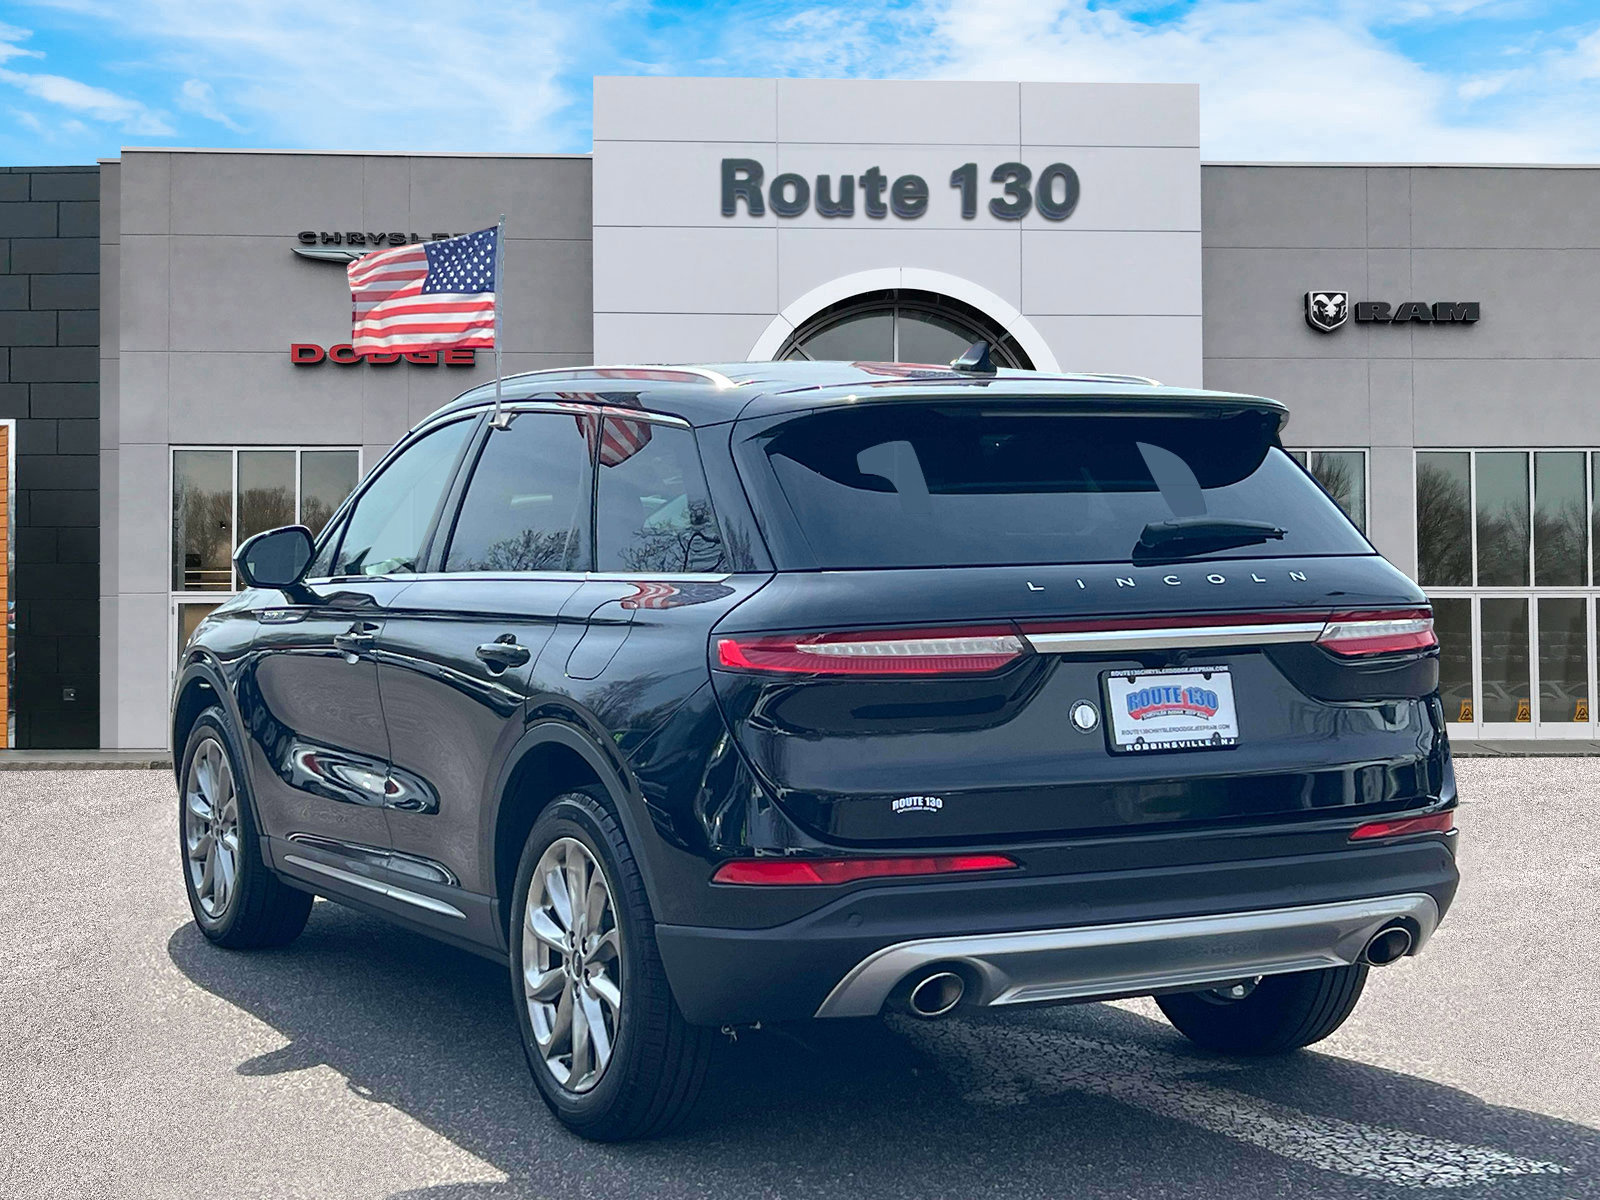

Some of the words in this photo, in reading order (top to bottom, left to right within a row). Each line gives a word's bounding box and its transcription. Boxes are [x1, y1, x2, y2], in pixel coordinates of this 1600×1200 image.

[720, 158, 929, 219] Route
[949, 162, 1080, 221] 130
[1354, 301, 1480, 324] RAM
[1027, 570, 1307, 592] LINCOLN
[1126, 685, 1182, 712] ROUTE
[1185, 686, 1219, 710] 130
[892, 796, 924, 811] ROUTE
[924, 796, 943, 809] 130
